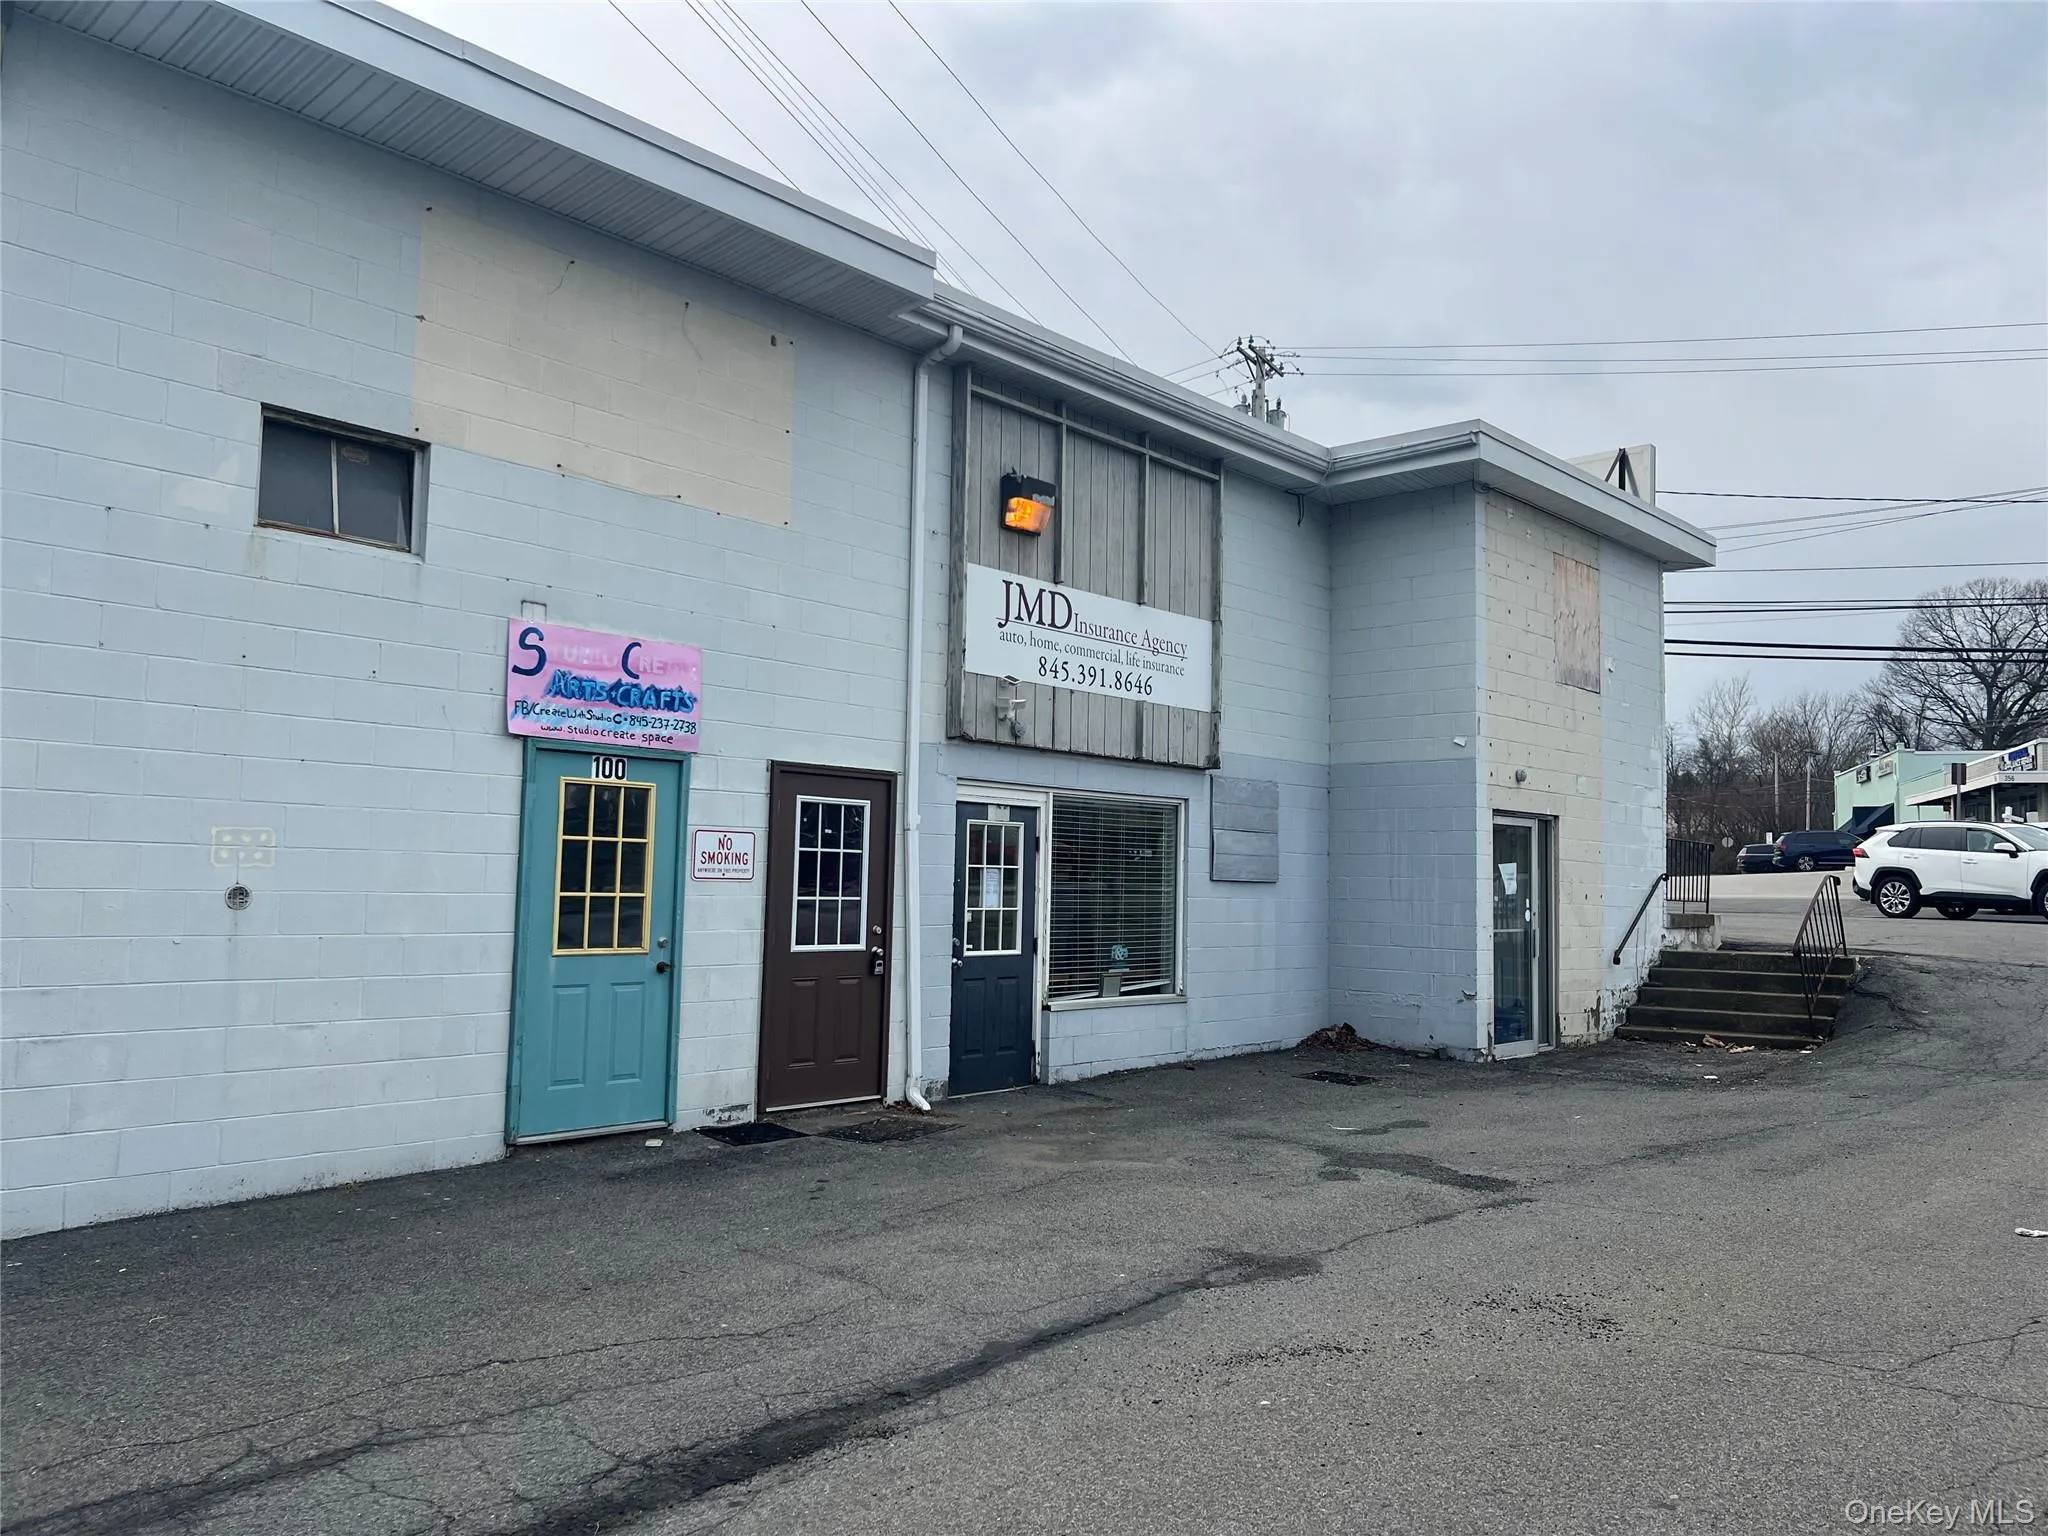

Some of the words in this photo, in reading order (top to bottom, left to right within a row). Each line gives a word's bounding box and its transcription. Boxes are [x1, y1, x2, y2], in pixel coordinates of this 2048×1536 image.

[997, 579, 1073, 629] JMD
[1074, 612, 1138, 645] Insurance
[1141, 630, 1188, 662] Agency
[1000, 630, 1027, 647] auto,
[1030, 630, 1062, 653] home,
[1064, 643, 1124, 666] commercial,
[1126, 650, 1141, 668] life
[1142, 656, 1185, 677] insurance
[1038, 655, 1153, 696] 845.391.8646
[593, 756, 626, 780] 100
[700, 851, 749, 865] SMOKING
[718, 837, 732, 850] NO
